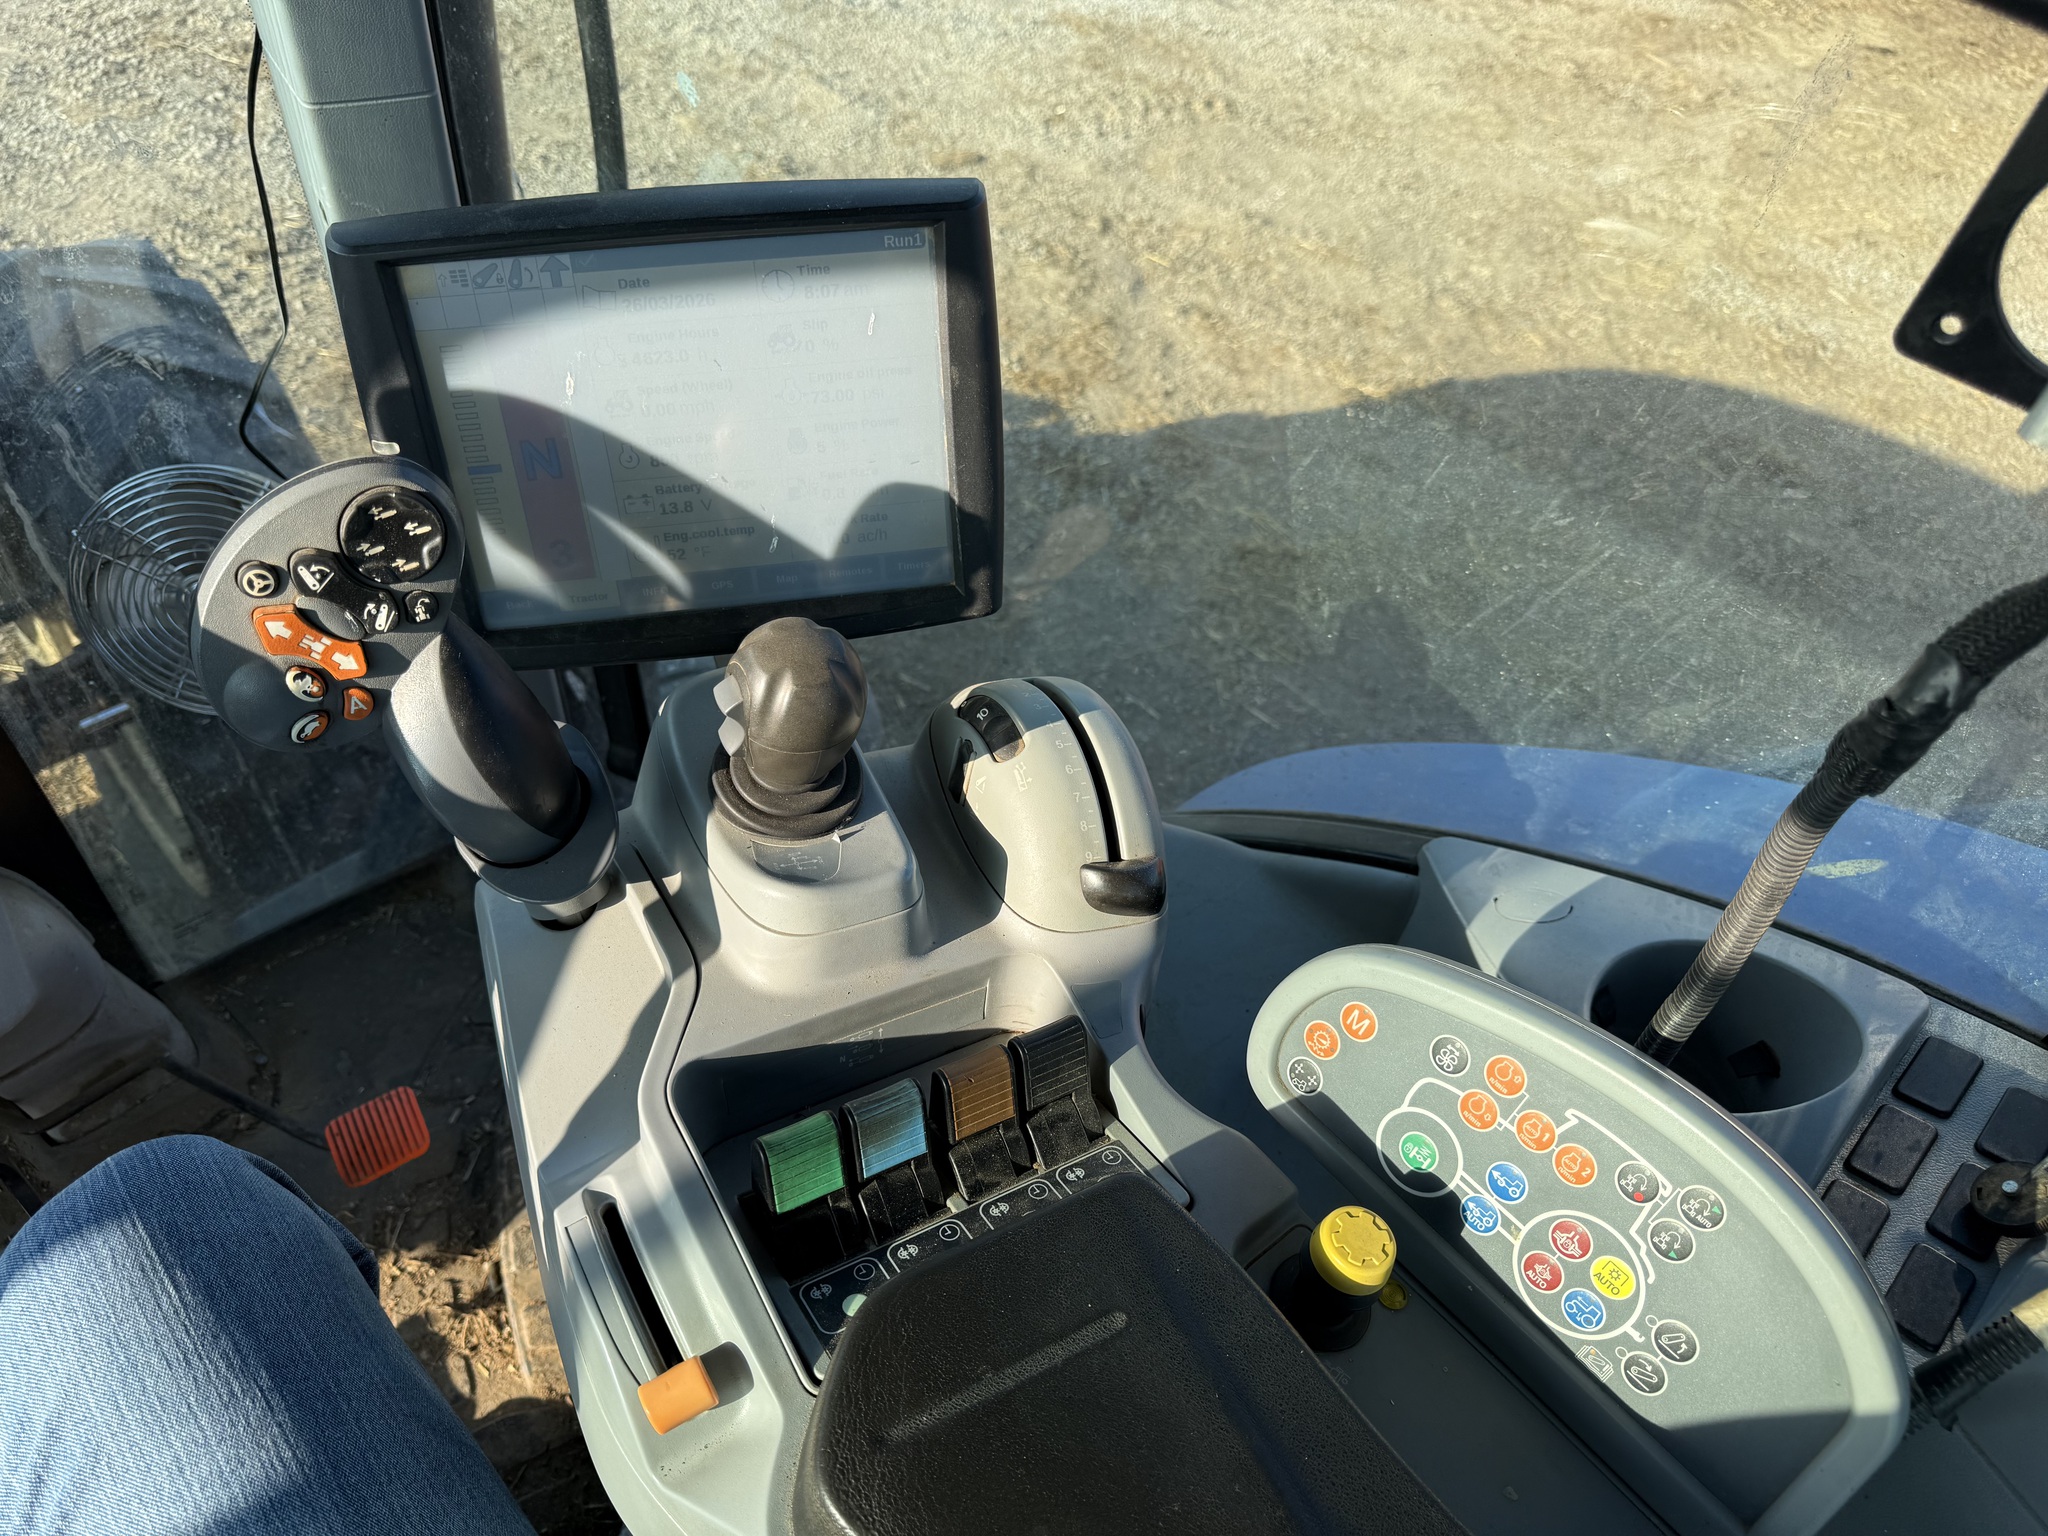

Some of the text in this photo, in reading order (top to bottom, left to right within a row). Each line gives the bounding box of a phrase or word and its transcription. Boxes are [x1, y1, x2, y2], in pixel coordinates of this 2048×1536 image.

[884, 233, 923, 248] Run1
[797, 265, 831, 277] Time
[617, 278, 650, 290] Date
[519, 437, 563, 482] N
[655, 483, 701, 496] Battery
[659, 499, 712, 516] 13.8 V
[860, 512, 889, 524] Rate
[663, 525, 756, 543] Eng.cool.temp
[550, 539, 575, 567] 3
[350, 695, 368, 714] A
[976, 708, 989, 721] 10
[1055, 739, 1064, 749] 5
[1065, 764, 1073, 774] 6
[1073, 792, 1081, 803] 7
[1080, 820, 1088, 831] 8
[1085, 851, 1093, 863] 9
[1345, 1008, 1371, 1036] M
[1489, 1076, 1509, 1094] n/min
[1462, 1110, 1482, 1128] n/min
[1518, 1132, 1537, 1150] n/min
[1542, 1132, 1551, 1142] 1
[1557, 1165, 1577, 1183] n/min
[1581, 1167, 1592, 1178] 2
[1463, 1210, 1486, 1231] AUTO
[1695, 1213, 1712, 1228] AUTO
[1525, 1269, 1548, 1289] AUTO
[1593, 1272, 1621, 1296] AUTO
